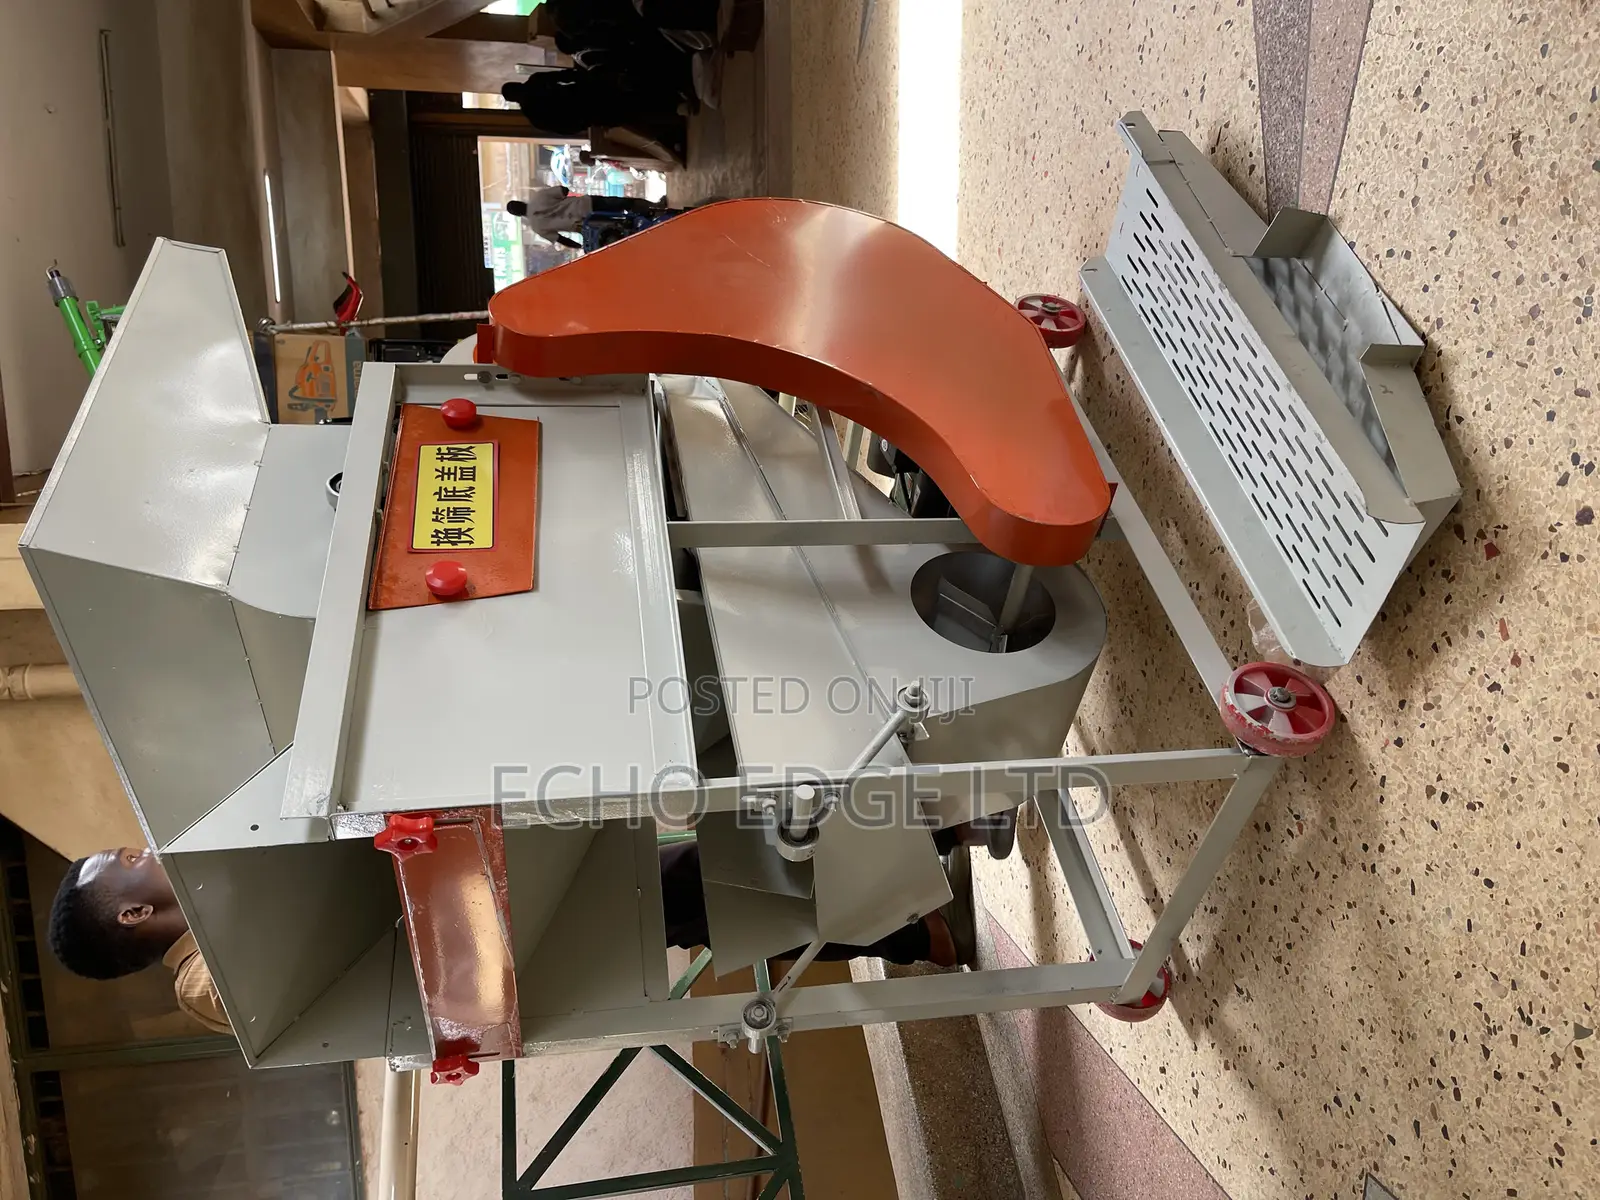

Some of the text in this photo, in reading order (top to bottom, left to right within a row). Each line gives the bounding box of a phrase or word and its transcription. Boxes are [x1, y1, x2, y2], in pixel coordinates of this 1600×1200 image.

[430, 445, 477, 546] 换筛底盖板
